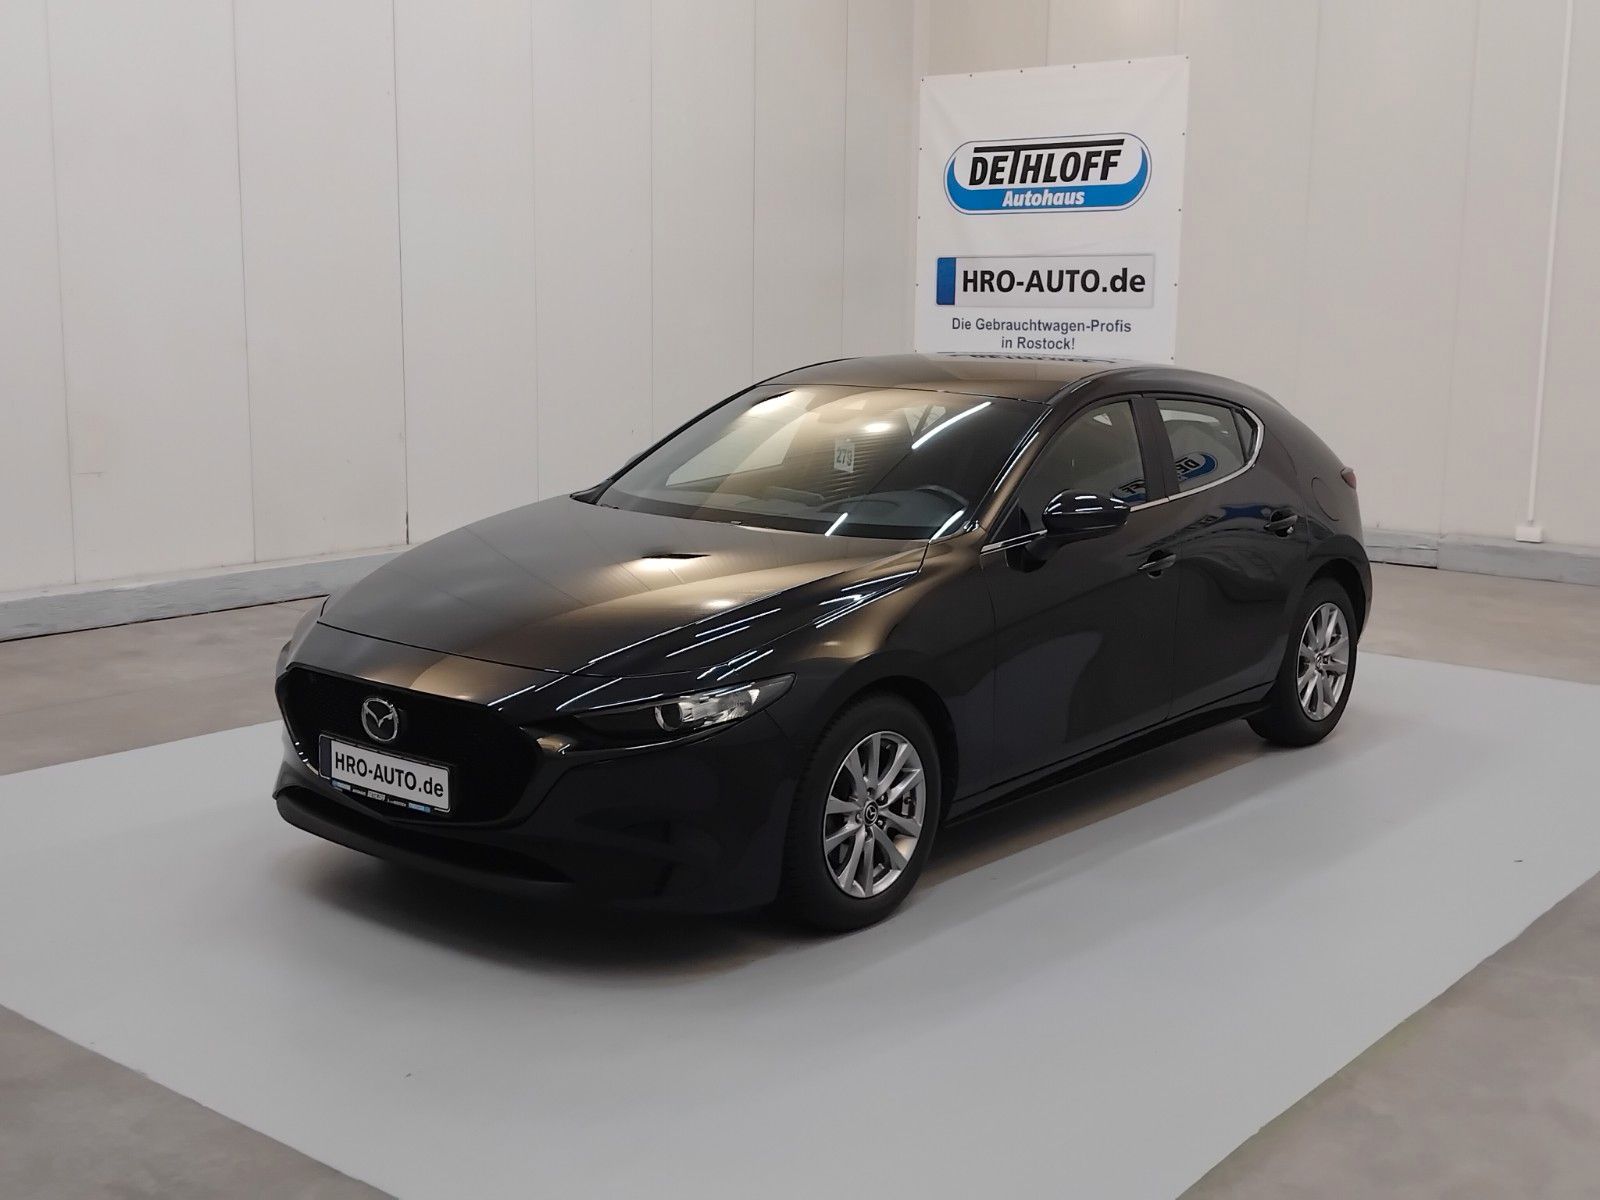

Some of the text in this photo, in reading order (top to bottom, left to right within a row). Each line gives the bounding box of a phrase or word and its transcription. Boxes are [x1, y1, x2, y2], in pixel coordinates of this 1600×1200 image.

[969, 138, 1125, 186] DETHLOFF
[1002, 189, 1085, 208] Autohaus
[962, 267, 1146, 293] HRO-AUTO.de
[952, 317, 1132, 334] Die Gebrauchtwagen-Profis
[1001, 337, 1075, 350] in Rostock!
[335, 751, 444, 797] HRO-AUTO.de
